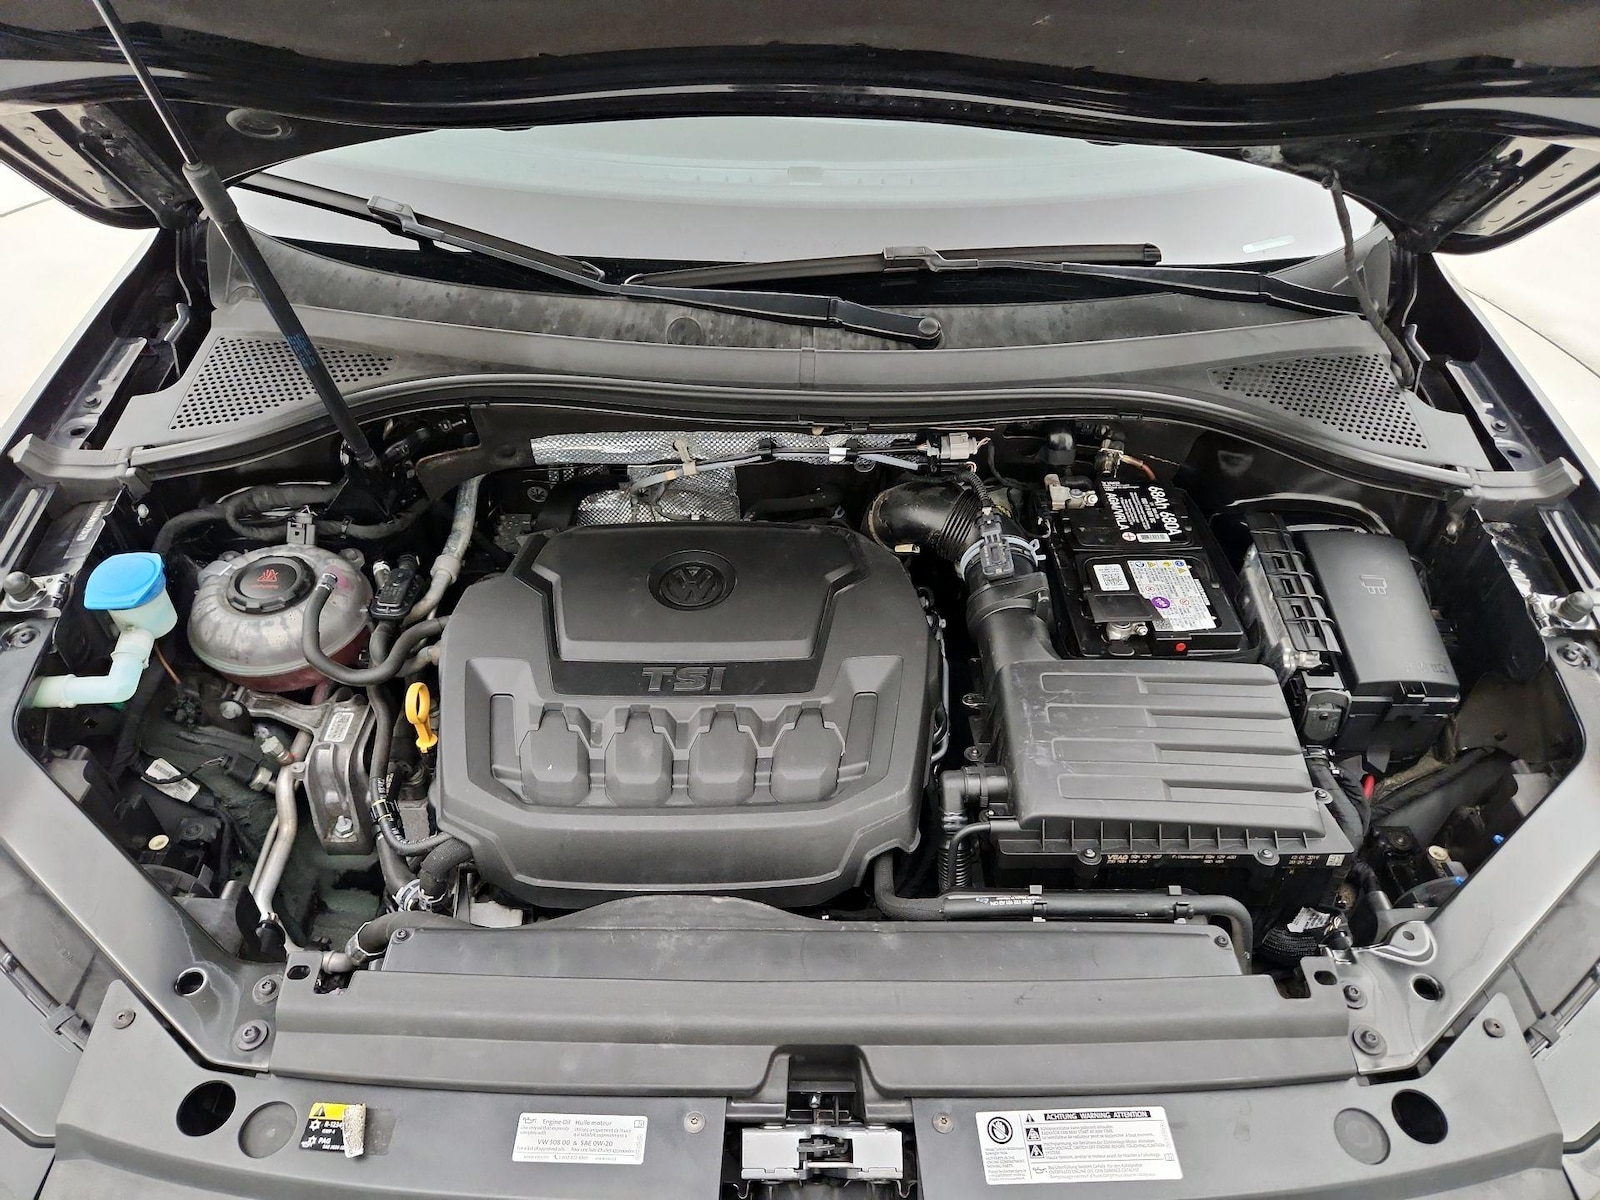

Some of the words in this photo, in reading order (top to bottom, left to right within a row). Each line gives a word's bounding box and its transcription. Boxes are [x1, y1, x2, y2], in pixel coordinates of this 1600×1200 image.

[1148, 486, 1170, 510] 68Ah
[1159, 511, 1183, 536] 680A
[642, 666, 727, 692] TSI
[1045, 1112, 1078, 1121] ACHTUNG
[1080, 1111, 1111, 1120] WARNING
[1113, 1110, 1148, 1119] ATTENTION
